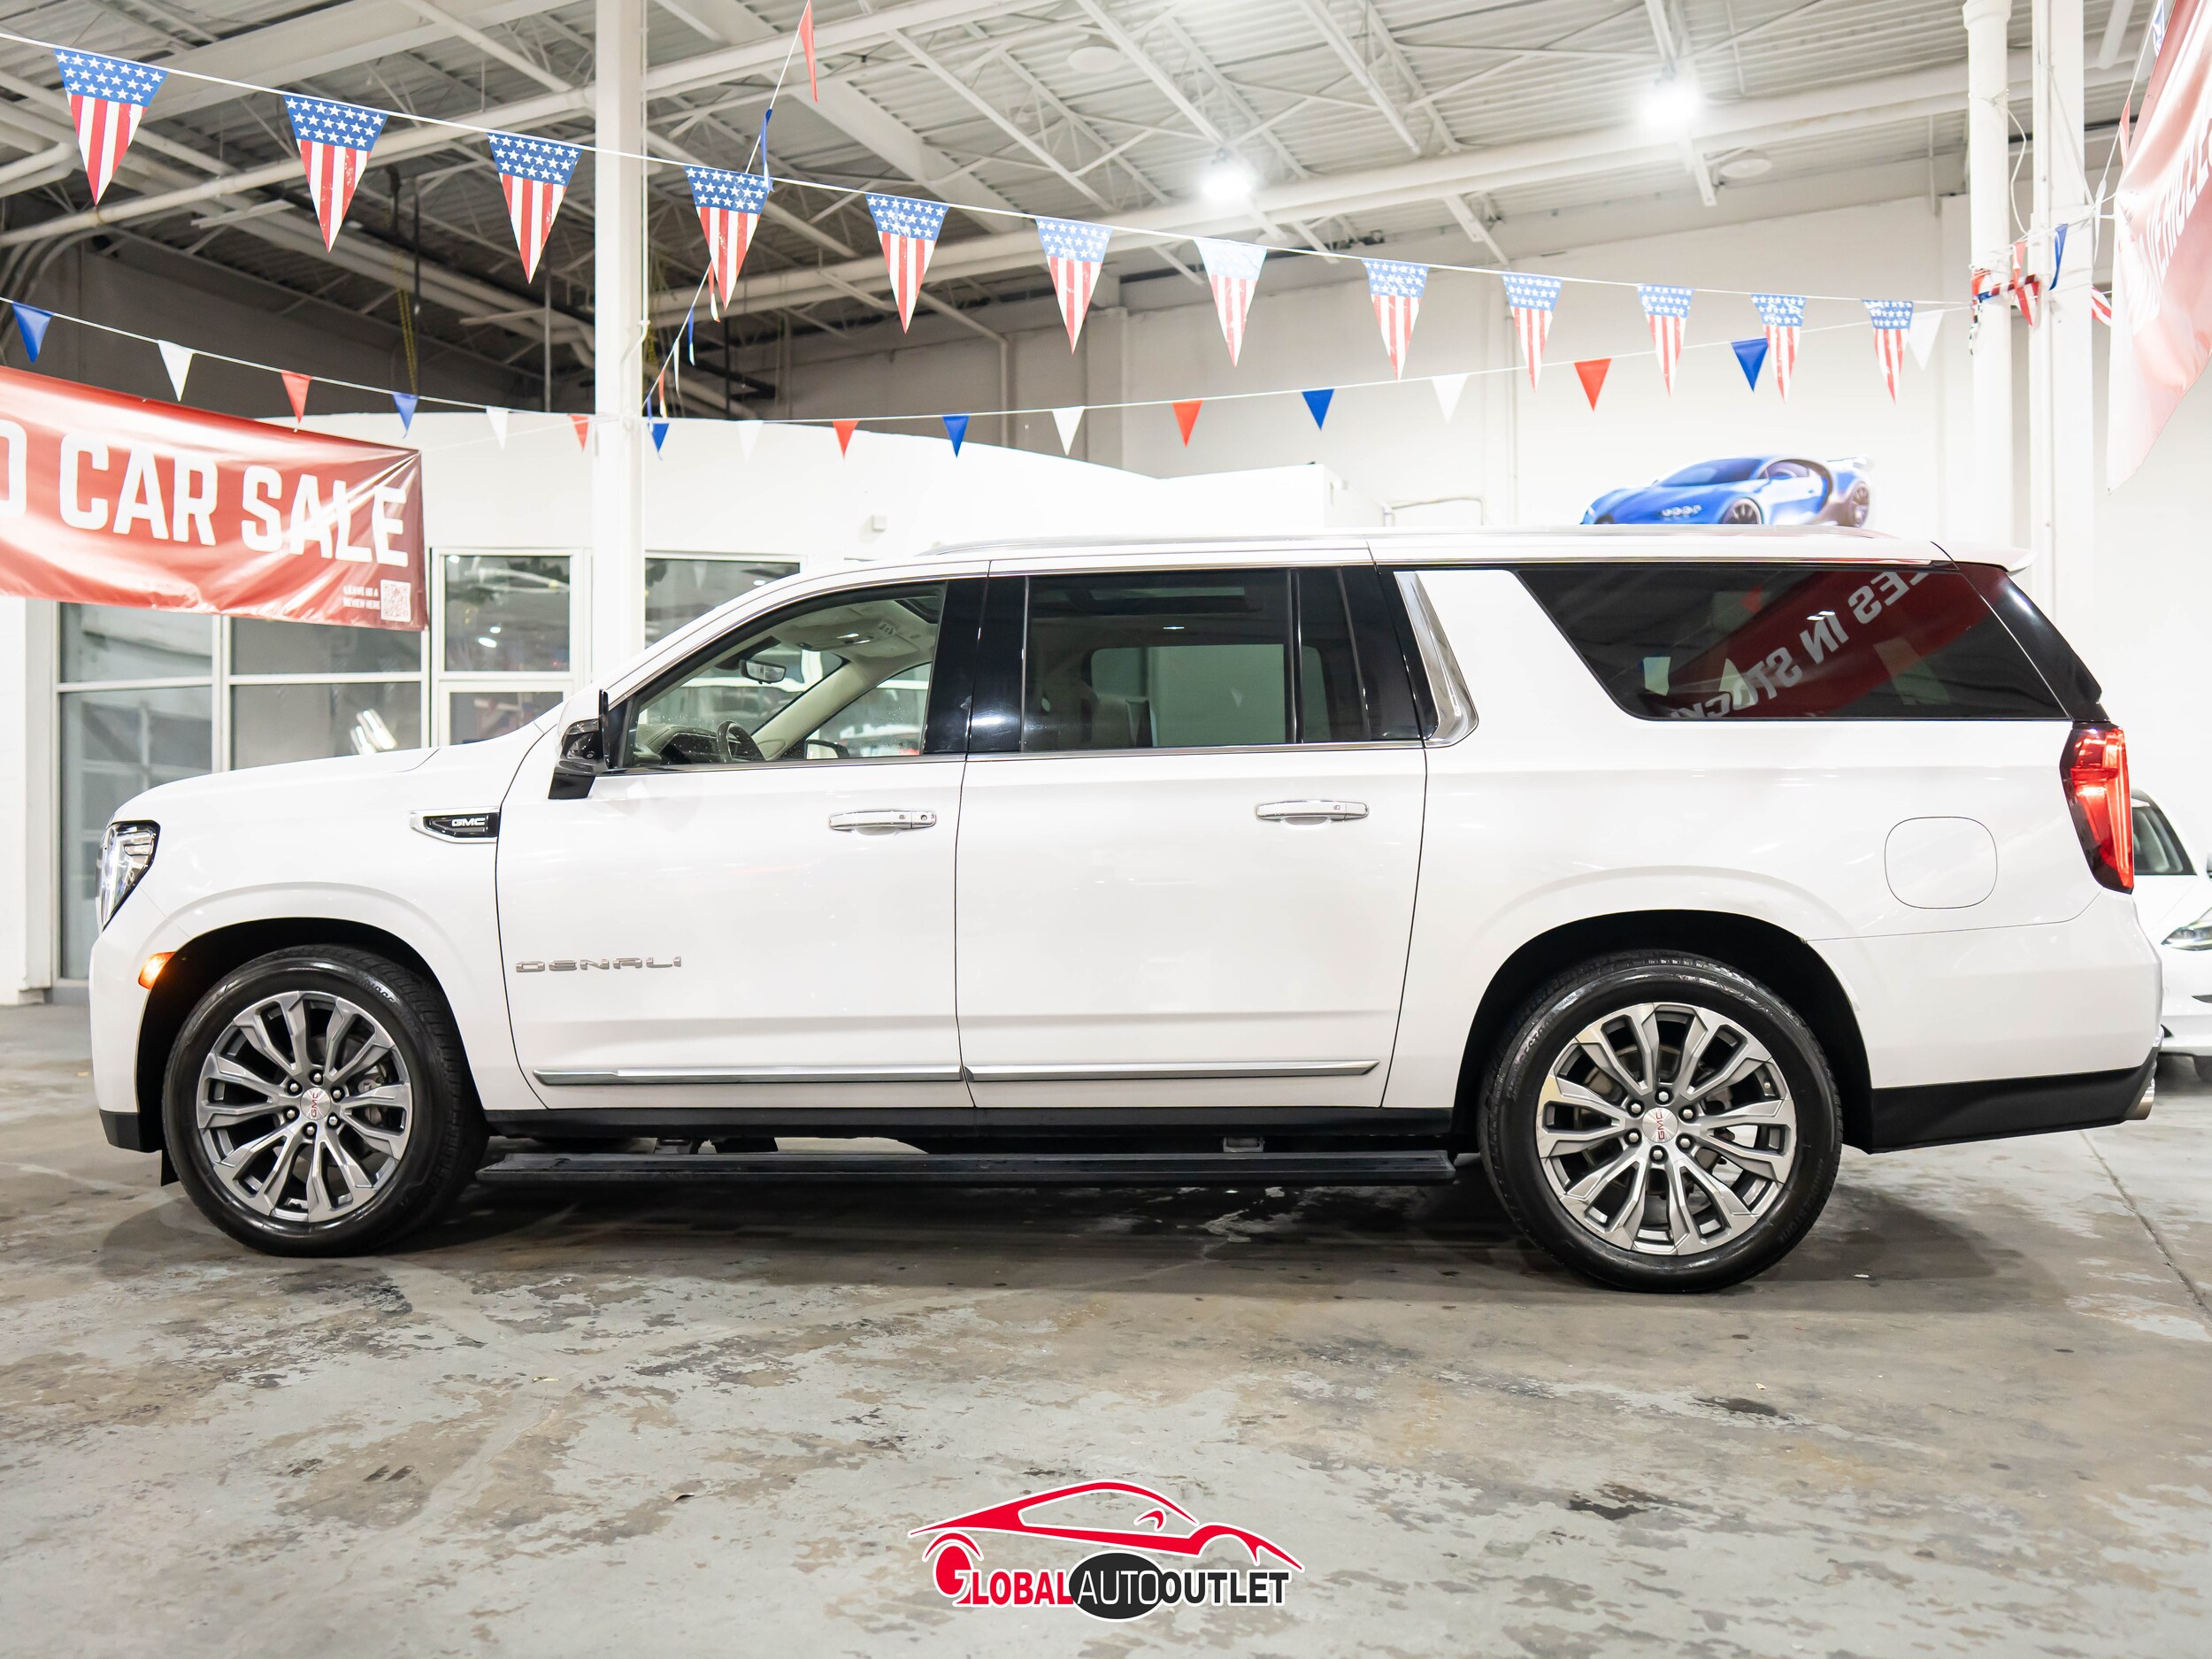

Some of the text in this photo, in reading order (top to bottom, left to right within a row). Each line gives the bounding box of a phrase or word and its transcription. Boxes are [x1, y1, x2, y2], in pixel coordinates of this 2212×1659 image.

[60, 432, 219, 546] CAR
[242, 465, 410, 568] SALE
[451, 817, 487, 827] GMC
[515, 956, 682, 973] DENALI
[311, 1091, 319, 1118] GMC
[1655, 1110, 1665, 1141] GMC
